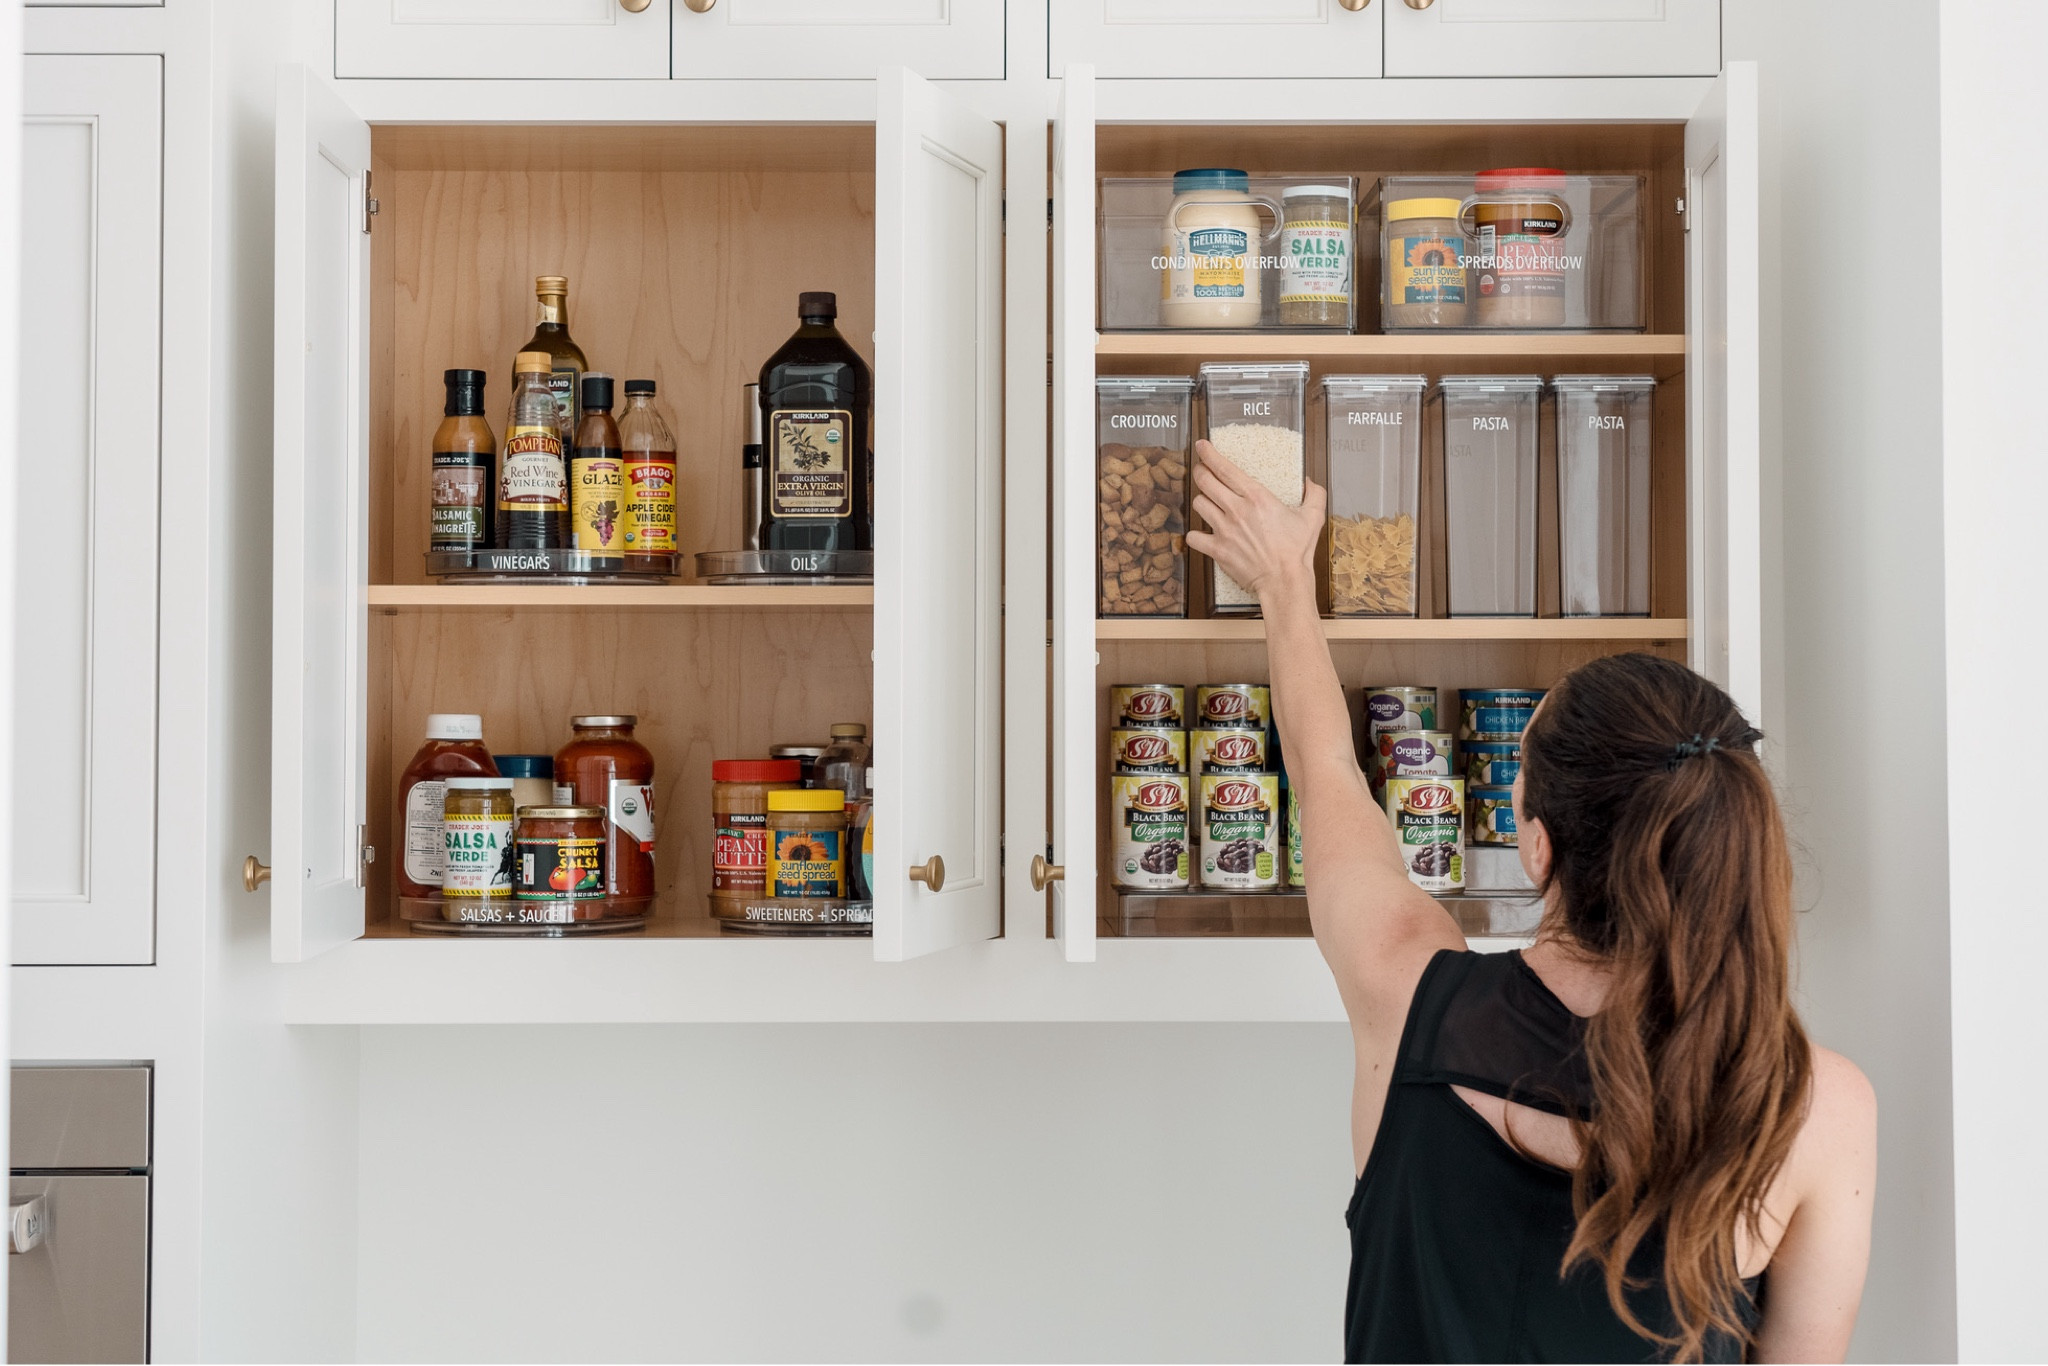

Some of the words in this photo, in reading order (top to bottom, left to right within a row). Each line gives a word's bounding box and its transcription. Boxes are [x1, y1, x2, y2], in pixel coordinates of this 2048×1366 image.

[1524, 220, 1557, 228] KIRKLAND
[1193, 233, 1245, 247] HELLMANN'S
[1291, 238, 1345, 256] SALSA
[1151, 256, 1232, 270] CONDIMENTS
[1235, 256, 1300, 270] OVERFLOW
[1299, 257, 1339, 269] VERDE
[1457, 255, 1515, 269] SPREADS
[1516, 255, 1582, 269] OVERFLOW
[1413, 266, 1461, 276] sunflower
[1408, 276, 1433, 285] seed
[1436, 276, 1464, 286] spread
[1243, 401, 1271, 417] RICE
[1111, 414, 1177, 429] CROUTONS
[1348, 411, 1403, 425] FARFALLE
[1473, 417, 1509, 430] PASTA
[1588, 416, 1625, 430] PASTA
[509, 437, 560, 454] POMPEIAN
[510, 466, 530, 478] Red
[532, 466, 559, 479] Wine
[636, 467, 671, 479] BRAGG
[513, 479, 556, 488] VINEGAR
[582, 473, 623, 486] GLAZE
[778, 482, 809, 490] EXTRA
[810, 482, 844, 490] VIRGIN
[432, 508, 472, 521] BALSAMIC
[626, 503, 654, 513] APPLE
[636, 513, 671, 523] VINEGAR
[491, 555, 550, 570] VINEGARS
[791, 557, 817, 571] OILS
[1134, 694, 1169, 713] S&W
[1210, 694, 1244, 714] S&W
[1495, 696, 1531, 704] KIRKLAND
[1369, 701, 1400, 713] Organic
[1485, 716, 1514, 724] CHICKEN
[1129, 738, 1165, 757] S&W
[1219, 738, 1254, 758] S&W
[1395, 745, 1431, 757] Organic
[1143, 784, 1178, 805] S&W
[1218, 784, 1256, 804] S&W
[1414, 787, 1450, 807] S&W
[730, 815, 765, 823] KIRKLAND
[1133, 812, 1162, 822] BLACK
[1163, 812, 1185, 822] BEANS
[1210, 812, 1237, 821] BLACK
[1238, 812, 1265, 821] BEANS
[1404, 815, 1432, 825] BLACK
[1433, 815, 1457, 825] BEANS
[1134, 822, 1182, 841] Organic
[1212, 822, 1262, 840] Organic
[1406, 825, 1455, 844] Organic
[445, 832, 497, 849] SALSA
[449, 851, 489, 862] VERDE
[557, 848, 599, 857] CHUNKY
[559, 857, 599, 869] SALSA
[781, 861, 832, 871] sunflower
[777, 870, 801, 880] seed
[802, 870, 836, 881] spread
[460, 907, 502, 922] SALSAS
[745, 906, 814, 922] SWEETENERS
